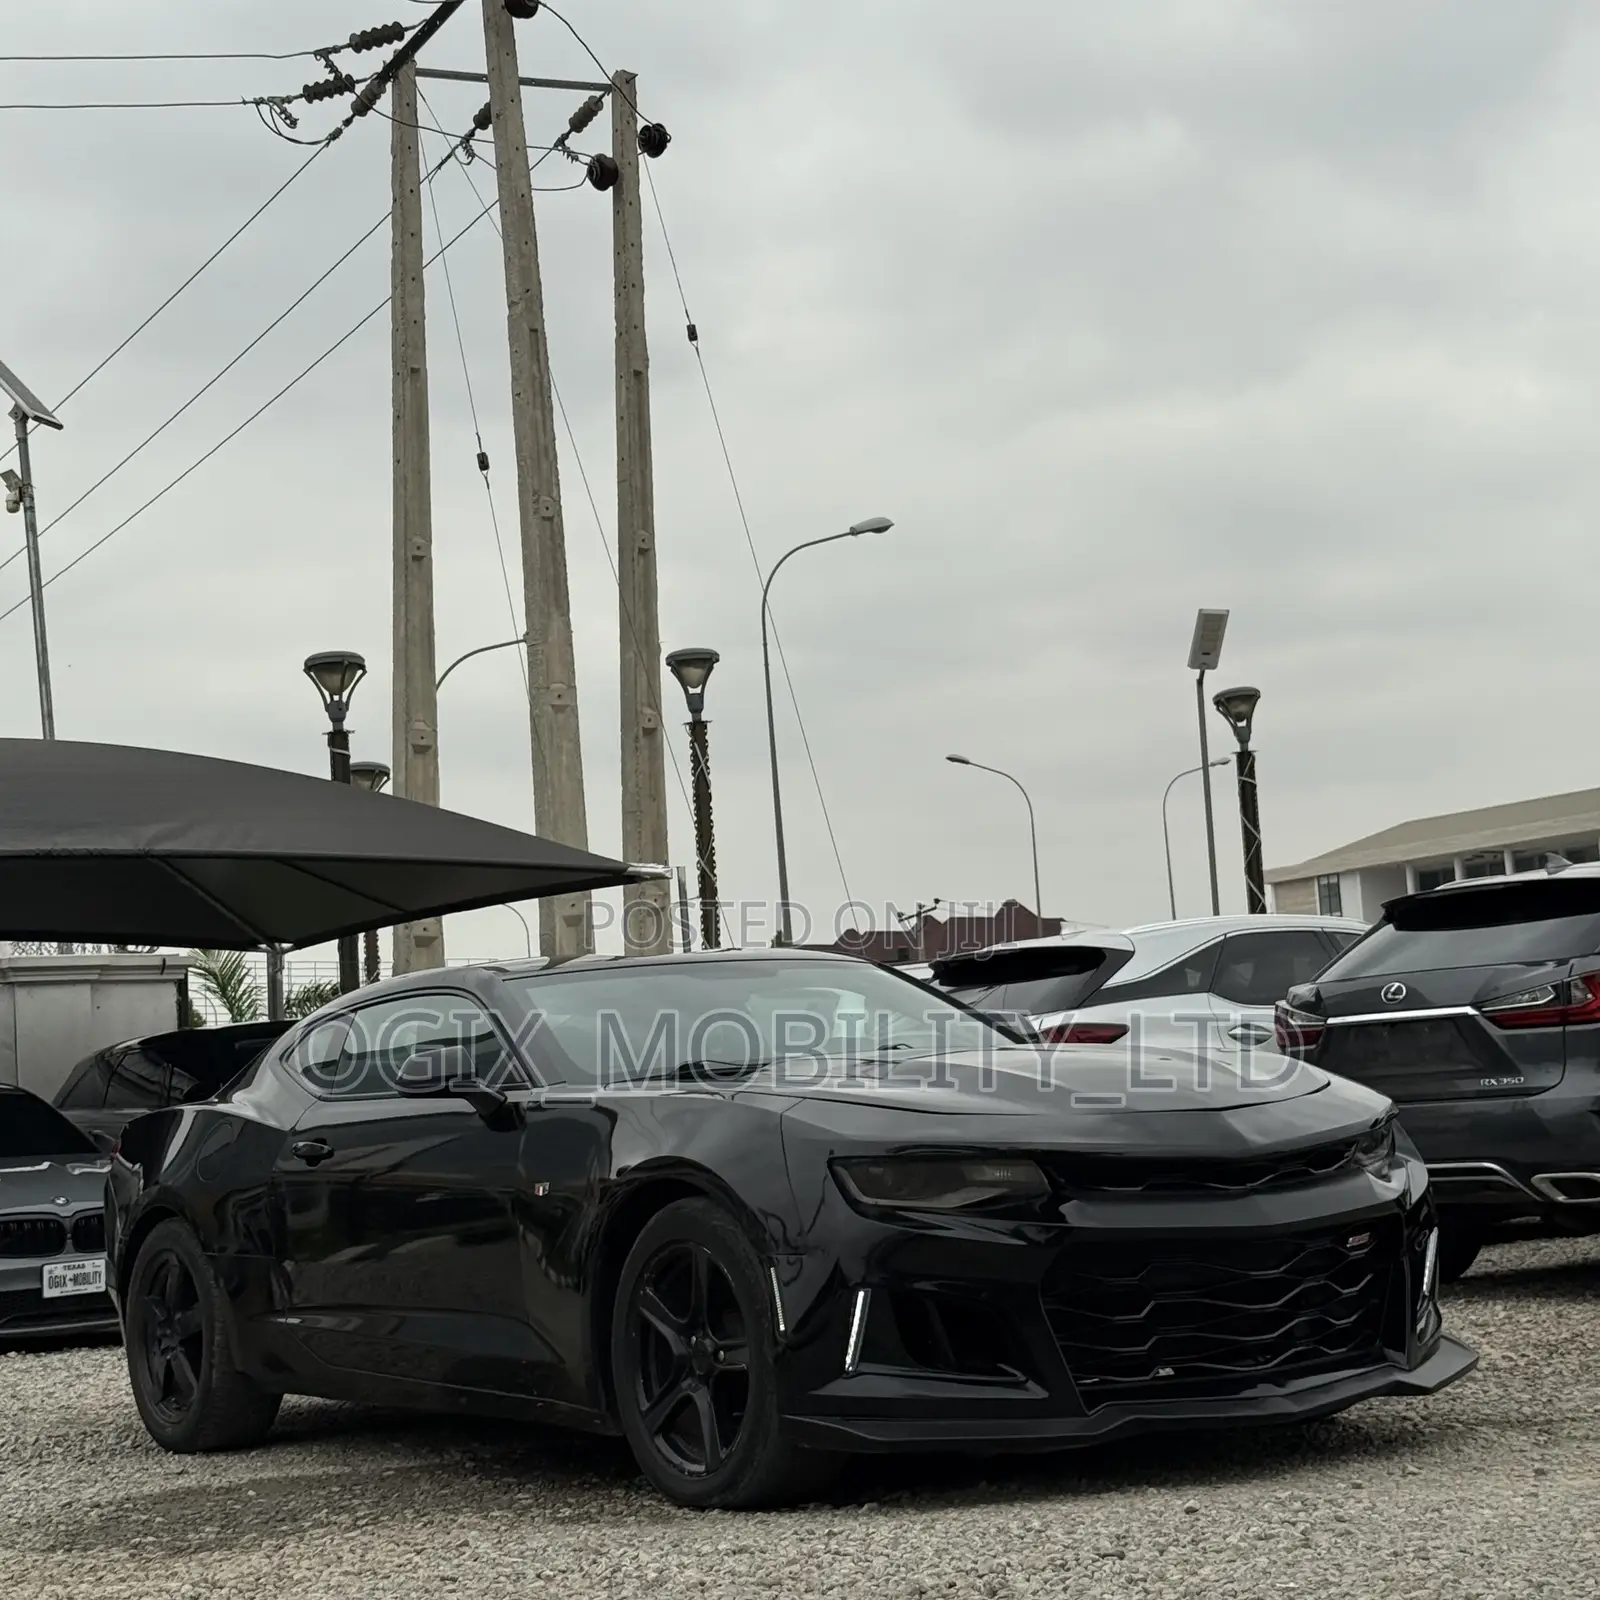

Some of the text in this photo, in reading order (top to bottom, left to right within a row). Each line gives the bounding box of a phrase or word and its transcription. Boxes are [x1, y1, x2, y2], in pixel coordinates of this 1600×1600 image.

[1480, 1076, 1524, 1086] RX 350
[63, 1263, 86, 1271] TEXAS
